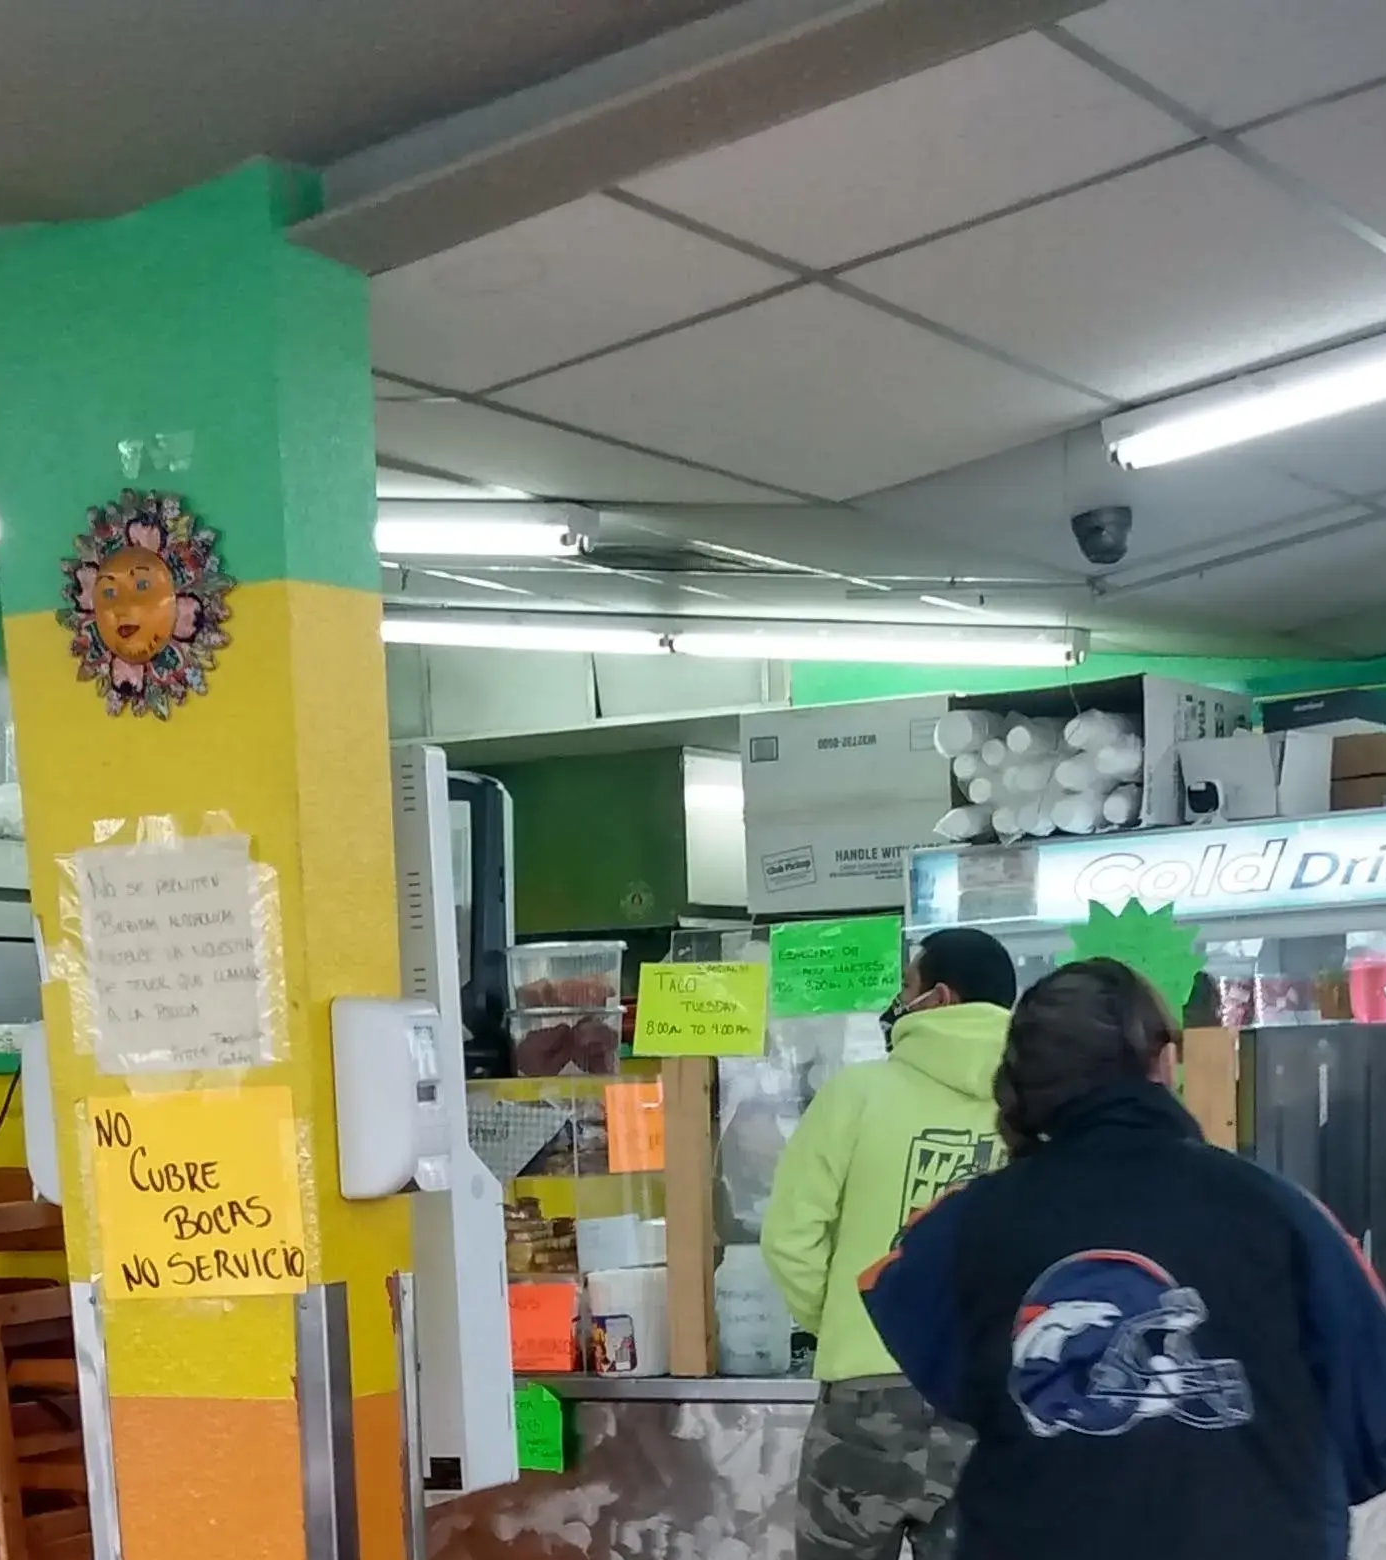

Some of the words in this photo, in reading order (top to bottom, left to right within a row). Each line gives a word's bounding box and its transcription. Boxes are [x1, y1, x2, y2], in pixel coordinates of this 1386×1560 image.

[835, 847, 878, 862] HANDLE
[1074, 838, 1289, 904] Cold
[654, 971, 697, 993] TACO
[680, 1000, 737, 1014] TUESDAY
[690, 1024, 706, 1035] TO
[94, 1108, 132, 1148] NO
[129, 1146, 220, 1194] CUBRE
[163, 1195, 272, 1241] BOCAS
[121, 1253, 161, 1293] NO
[166, 1240, 305, 1286] SERVICIO
